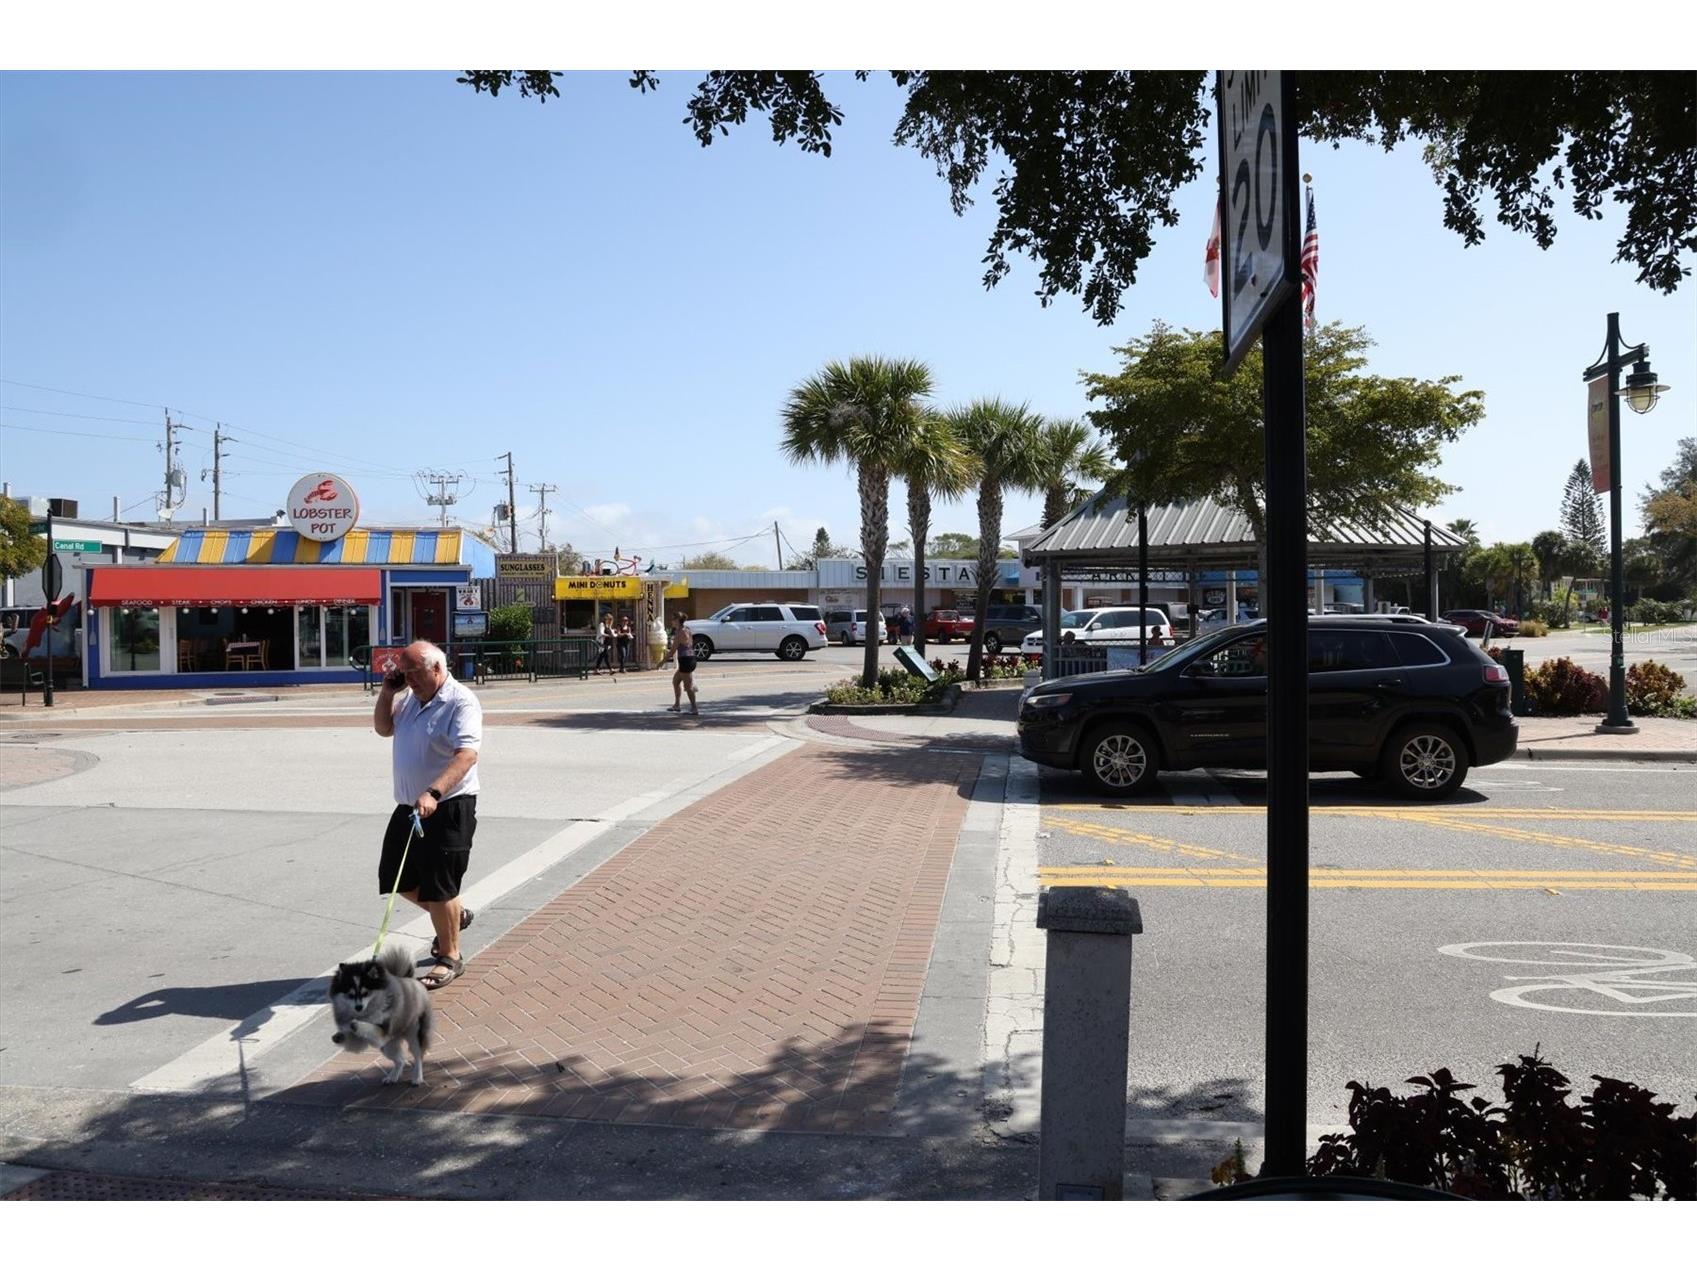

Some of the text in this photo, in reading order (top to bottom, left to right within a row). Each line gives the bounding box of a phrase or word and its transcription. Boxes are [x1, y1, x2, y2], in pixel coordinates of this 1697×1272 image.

[1232, 102, 1277, 300] 20
[293, 507, 353, 519] LOBSTER
[311, 523, 336, 534] POT
[54, 542, 74, 550] Canal
[500, 563, 545, 571] SUNGLASSES
[568, 580, 626, 589] MINI DONUTS
[647, 583, 655, 622] HENNA
